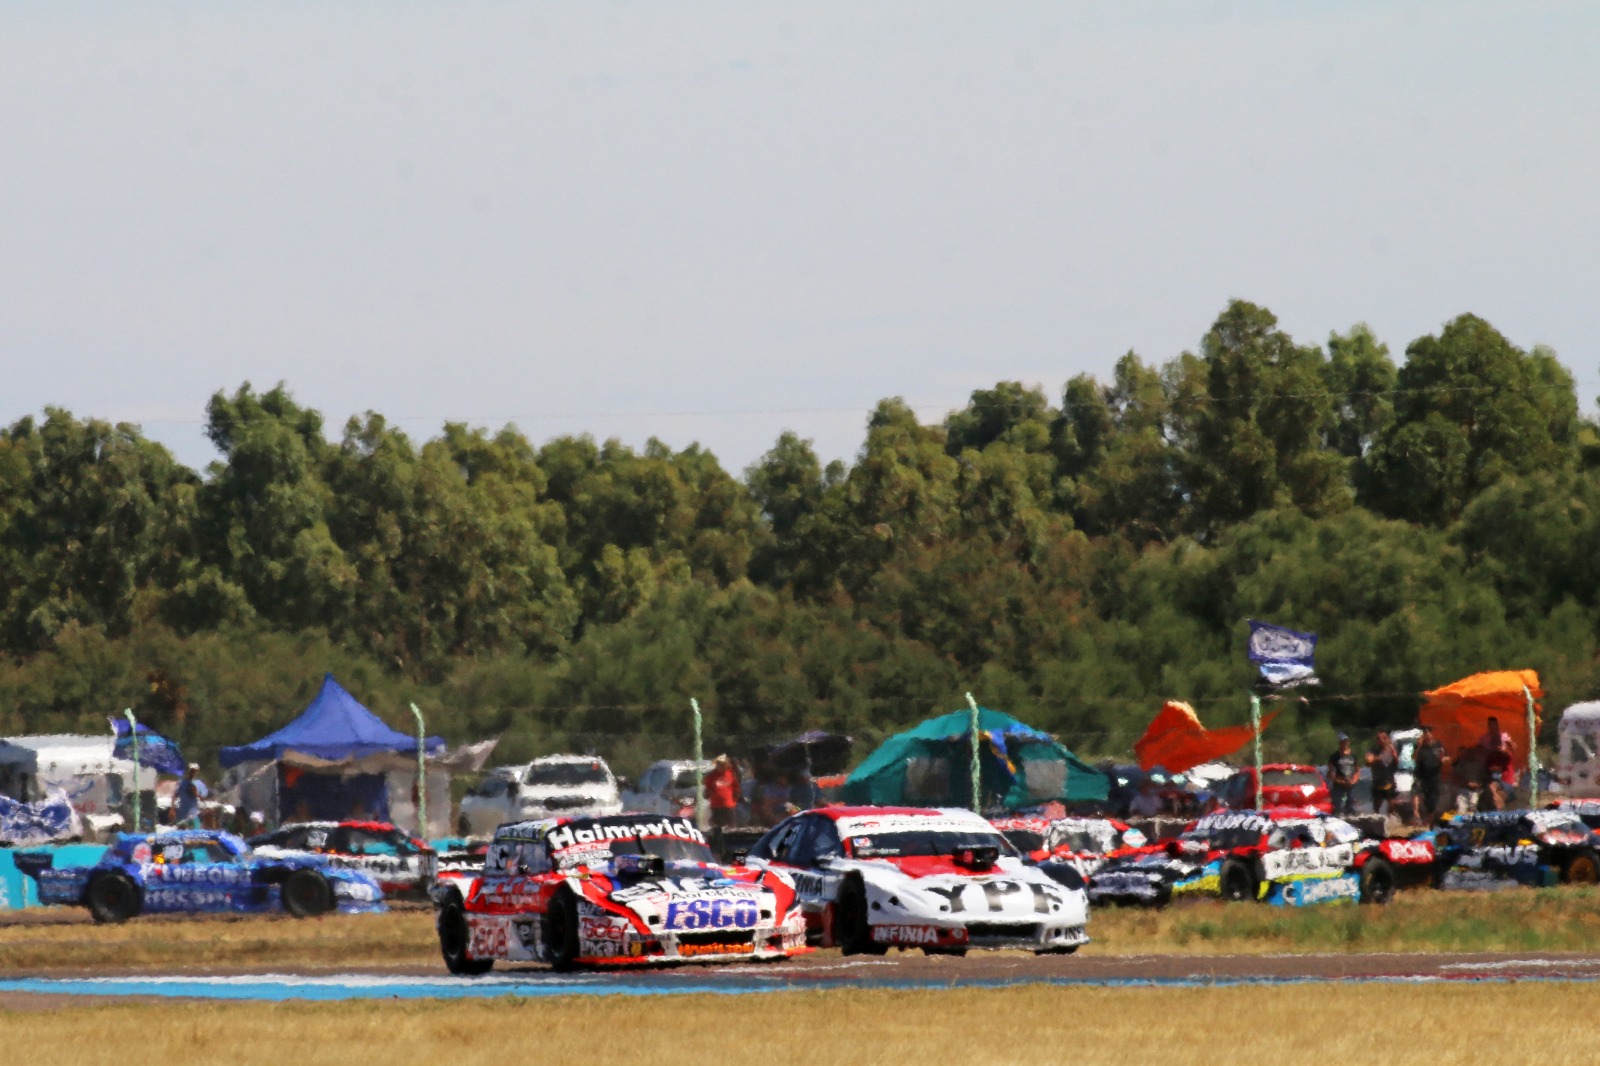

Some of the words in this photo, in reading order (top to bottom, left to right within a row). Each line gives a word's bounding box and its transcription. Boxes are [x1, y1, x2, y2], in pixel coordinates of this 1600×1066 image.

[548, 818, 705, 850] Haimovich
[922, 880, 1063, 915] YPF
[664, 899, 757, 929] ESCO
[874, 926, 939, 944] INFINIA
